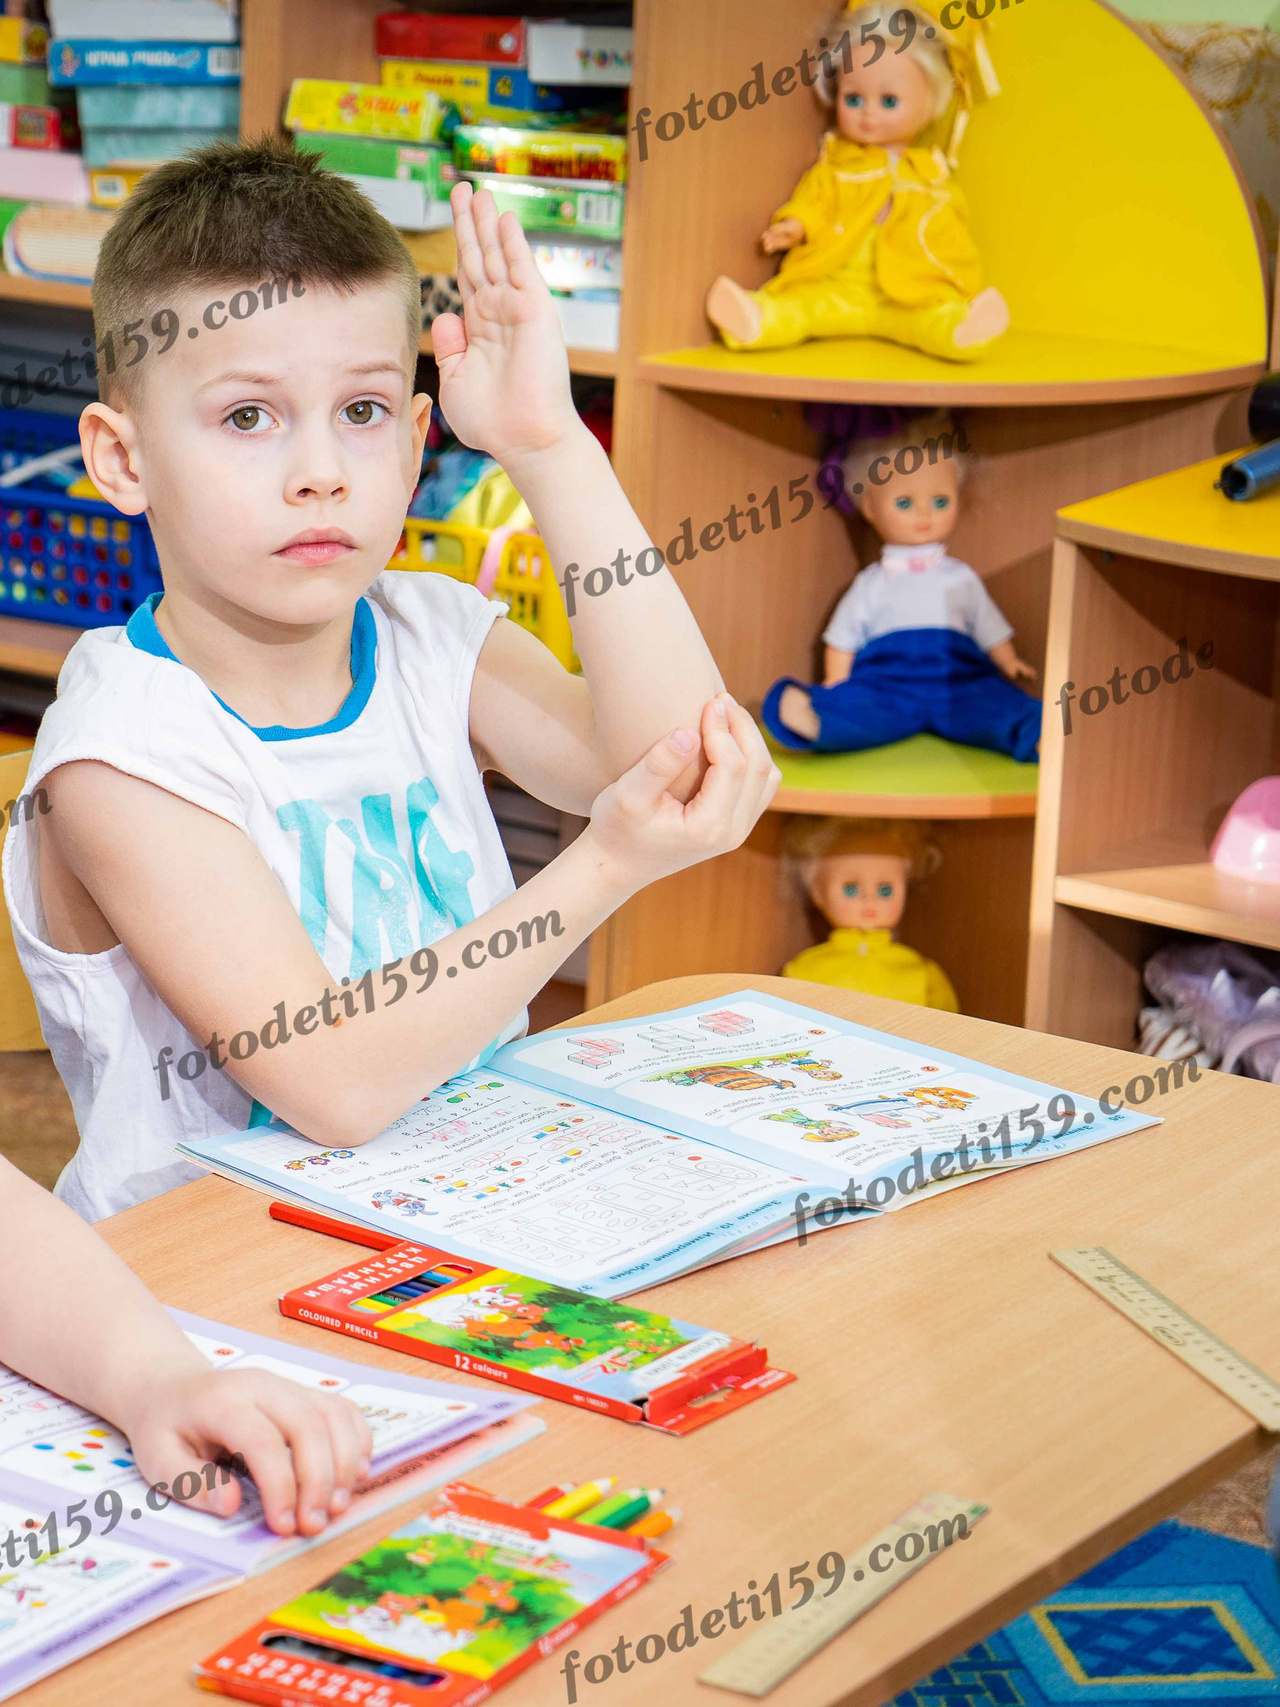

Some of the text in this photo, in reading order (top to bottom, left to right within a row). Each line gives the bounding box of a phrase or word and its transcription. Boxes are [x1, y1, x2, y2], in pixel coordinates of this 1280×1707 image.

[736, 1199, 783, 1221] Занятие
[653, 1230, 715, 1263] Измерение
[302, 1246, 423, 1299] КАРАНДАШИ
[337, 1255, 428, 1296] ЦВЕТНЫЕ
[298, 1307, 379, 1340] COLOURED PENCILS
[453, 1353, 509, 1380] 12 colours
